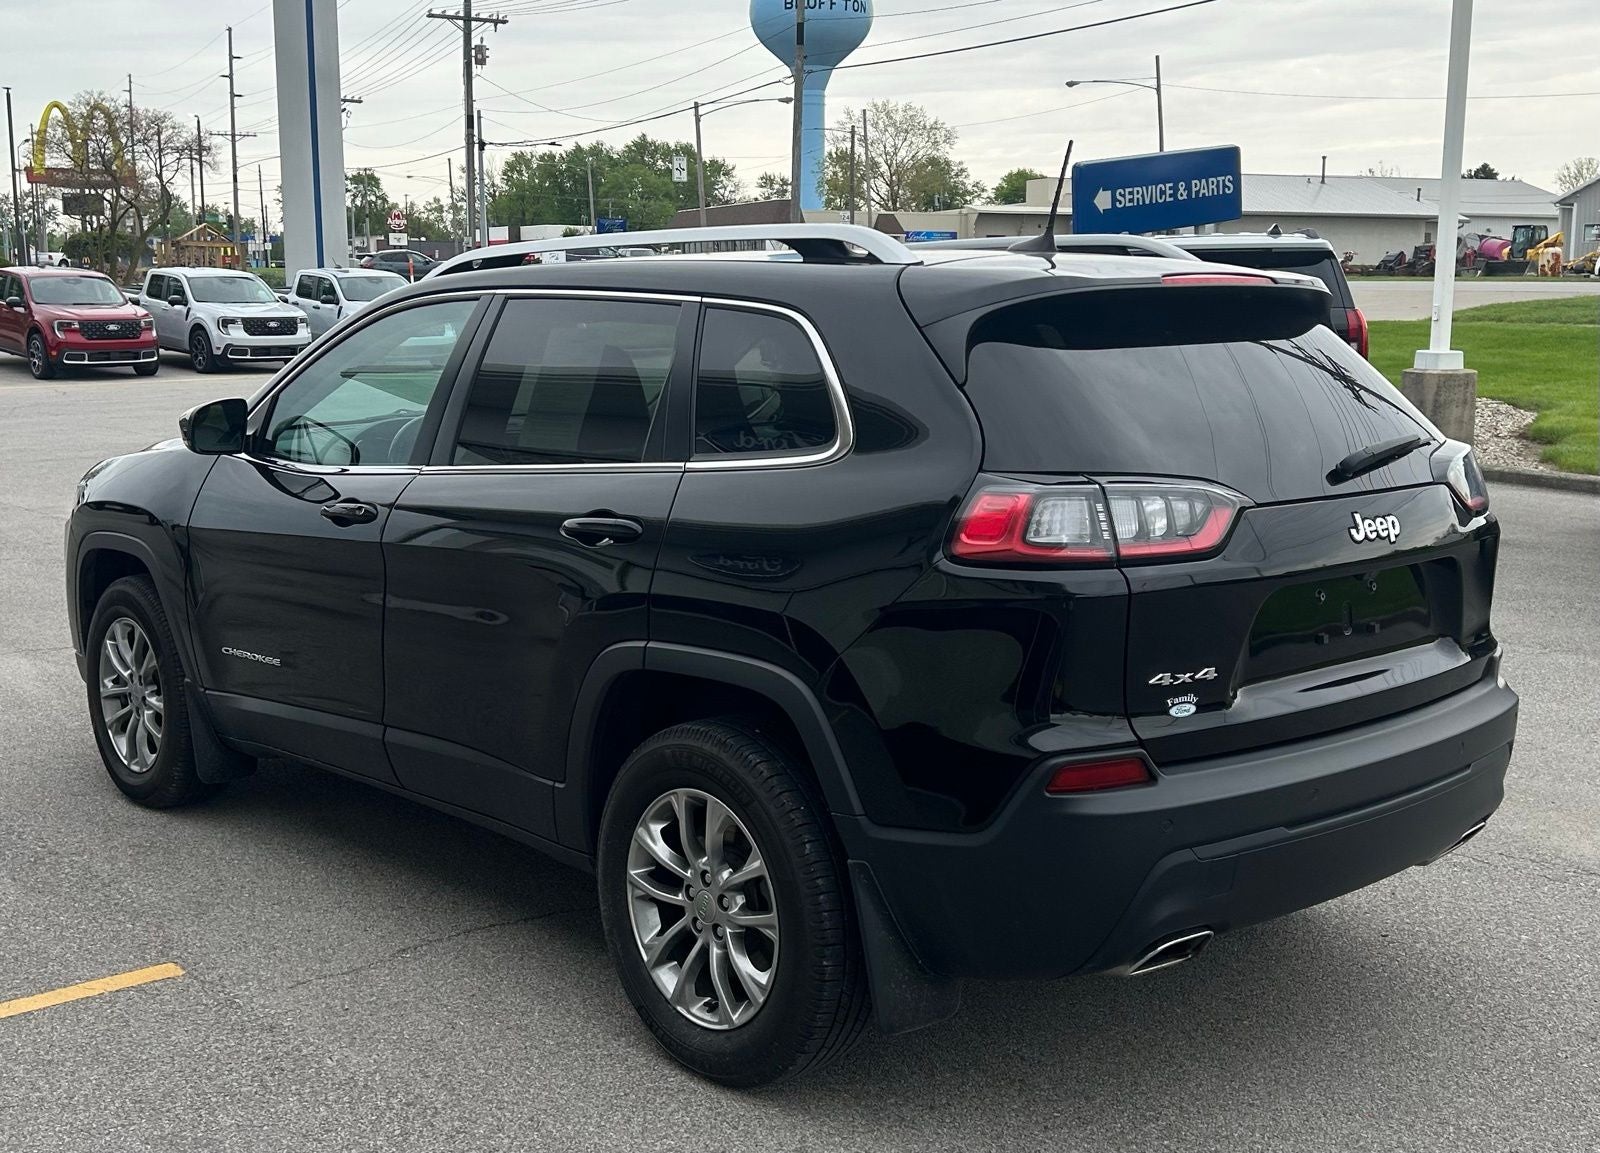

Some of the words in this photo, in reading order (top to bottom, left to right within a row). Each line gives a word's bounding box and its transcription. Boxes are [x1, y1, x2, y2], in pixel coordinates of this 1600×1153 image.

[1115, 183, 1174, 208] SERVICE
[1177, 181, 1188, 200] &
[1191, 175, 1234, 199] PARTS
[1348, 511, 1401, 545] Jeep
[221, 646, 281, 667] CHEROKEE
[1148, 667, 1218, 686] 4x4
[1166, 693, 1199, 707] Family
[1174, 705, 1191, 716] Ford
